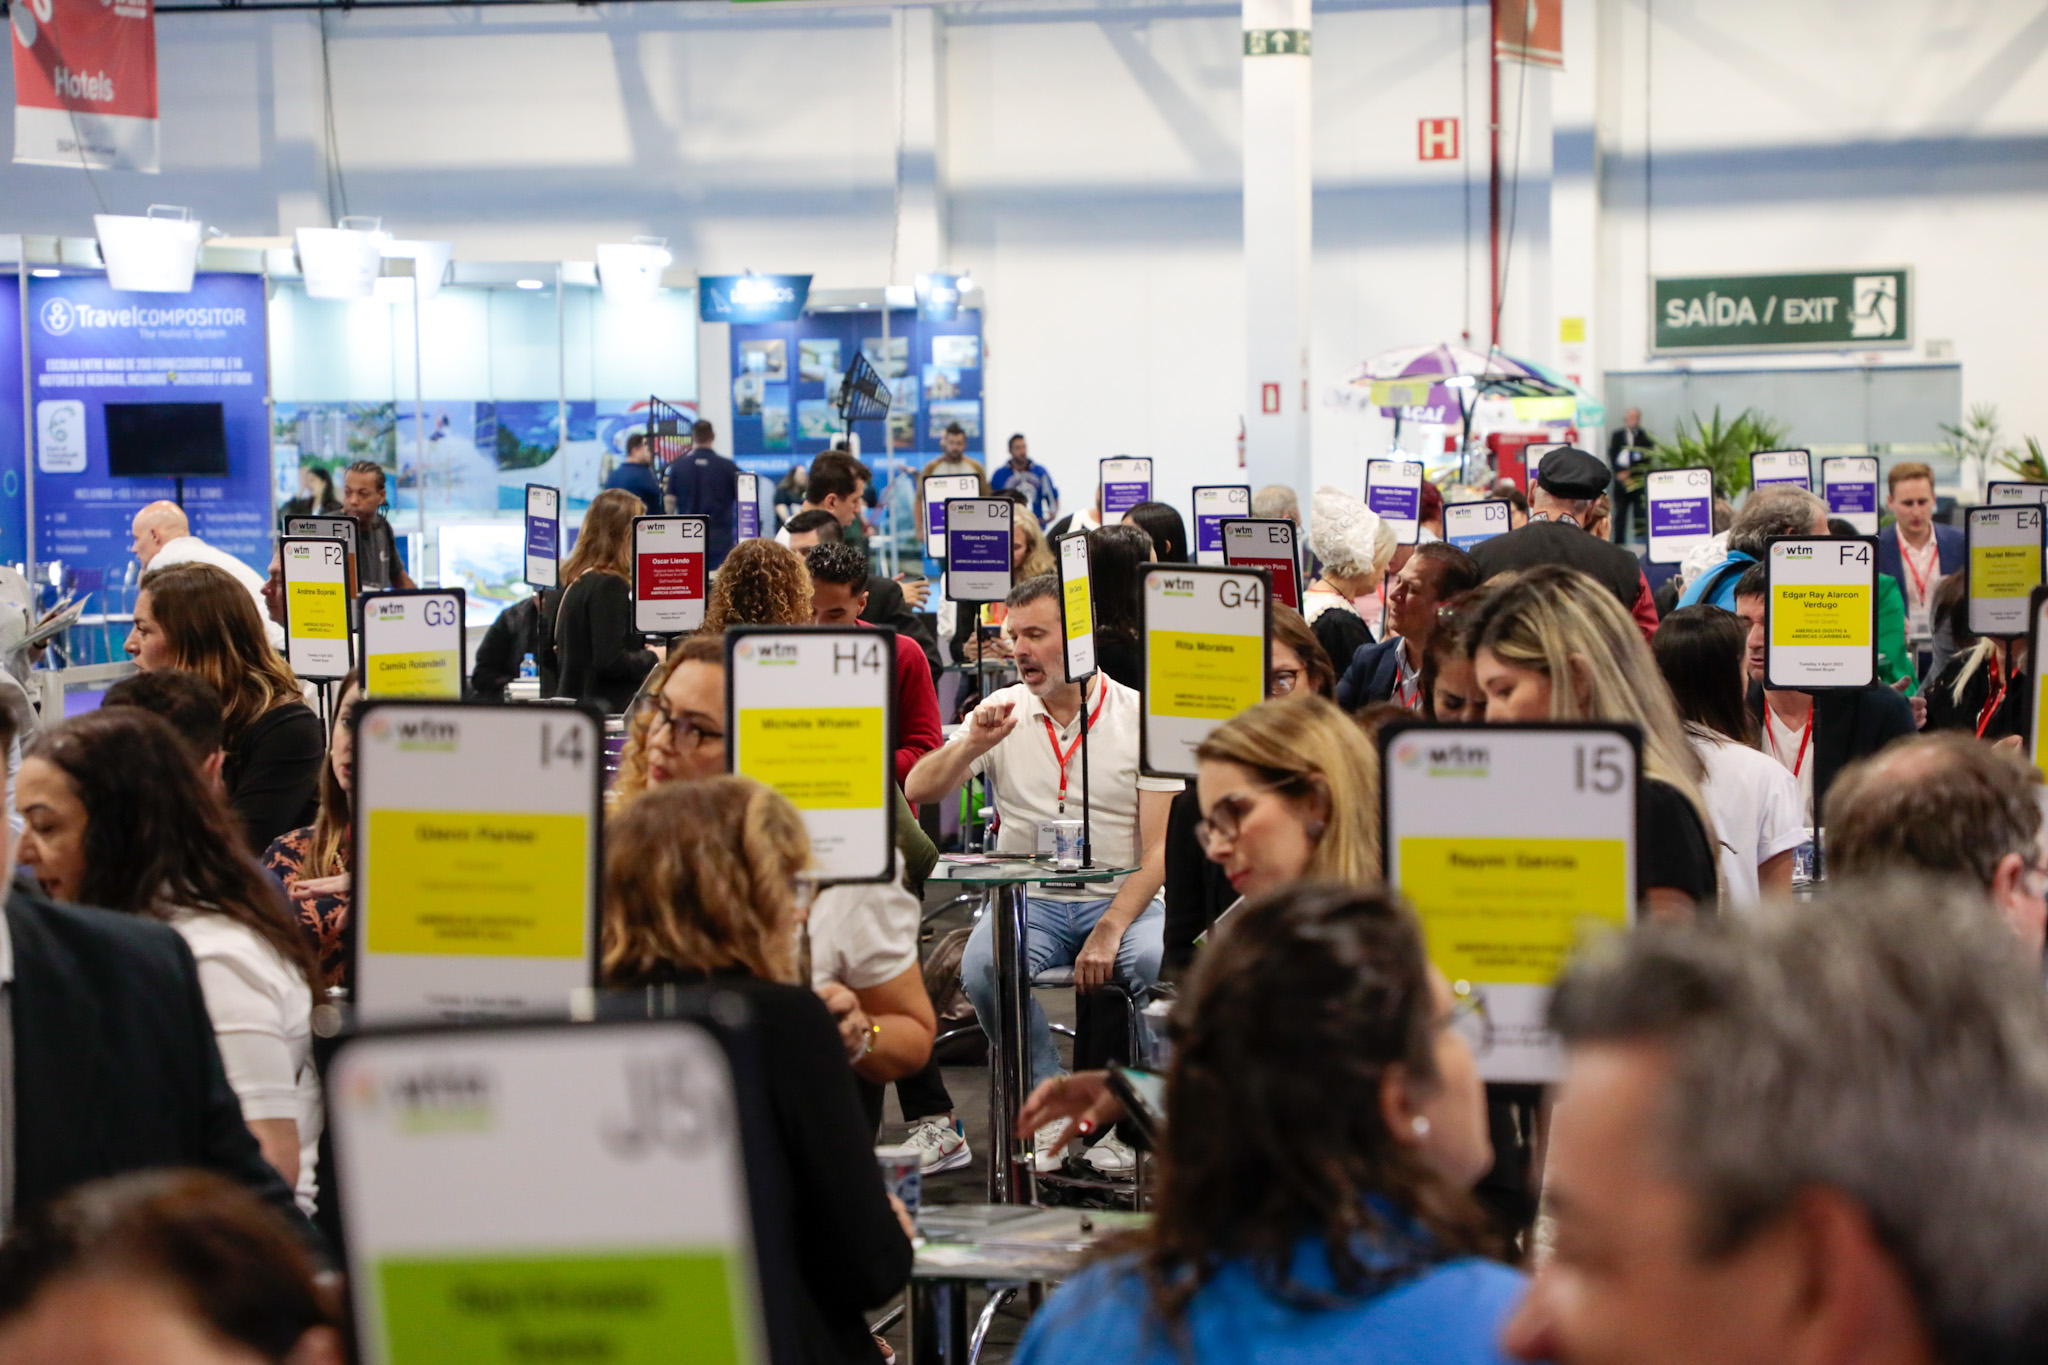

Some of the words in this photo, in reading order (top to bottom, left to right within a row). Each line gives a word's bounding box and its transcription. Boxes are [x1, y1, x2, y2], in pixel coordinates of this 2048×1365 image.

[54, 65, 115, 102] Hotels
[1422, 119, 1455, 158] H
[1666, 291, 1758, 328] SAÍDA
[1783, 297, 1839, 324] EXIT
[1133, 461, 1148, 472] A1
[1789, 454, 1807, 467] B3
[1858, 461, 1875, 472] A3
[1403, 464, 1420, 476] B2
[960, 479, 975, 490] B1
[1688, 472, 1709, 486] C3
[1228, 490, 1247, 503] C2
[2003, 487, 2022, 495] wtm
[546, 492, 556, 507] D1
[988, 504, 1009, 518] D2
[1485, 505, 1506, 520] D3
[1981, 513, 2000, 521] wtm
[299, 521, 316, 530] wtm
[2017, 512, 2040, 529] E4
[682, 522, 703, 538] E2
[1235, 526, 1253, 534] wtm
[1268, 527, 1290, 543] E3
[294, 546, 310, 554] wtm
[324, 546, 342, 565] F2
[1076, 539, 1086, 559] F3
[1786, 545, 1813, 555] wtm
[1840, 545, 1870, 565] F4
[1164, 576, 1194, 590] wtm
[297, 588, 316, 596] Andrew
[1219, 579, 1262, 609] G4
[1782, 591, 1807, 600] Edgar
[1809, 591, 1825, 600] Ray
[1827, 591, 1859, 599] Alarcon
[379, 602, 404, 614] wtm
[1803, 601, 1838, 609] Verdugo
[424, 600, 456, 627] G3
[758, 643, 798, 658] wtm
[1175, 640, 1194, 650] Rita
[1197, 642, 1234, 653] Morales
[833, 642, 882, 675] H4
[379, 662, 406, 671] Camilo
[398, 717, 457, 740] wtm
[540, 722, 584, 767] I4
[1429, 743, 1489, 765] wtm
[1574, 745, 1625, 794] I5
